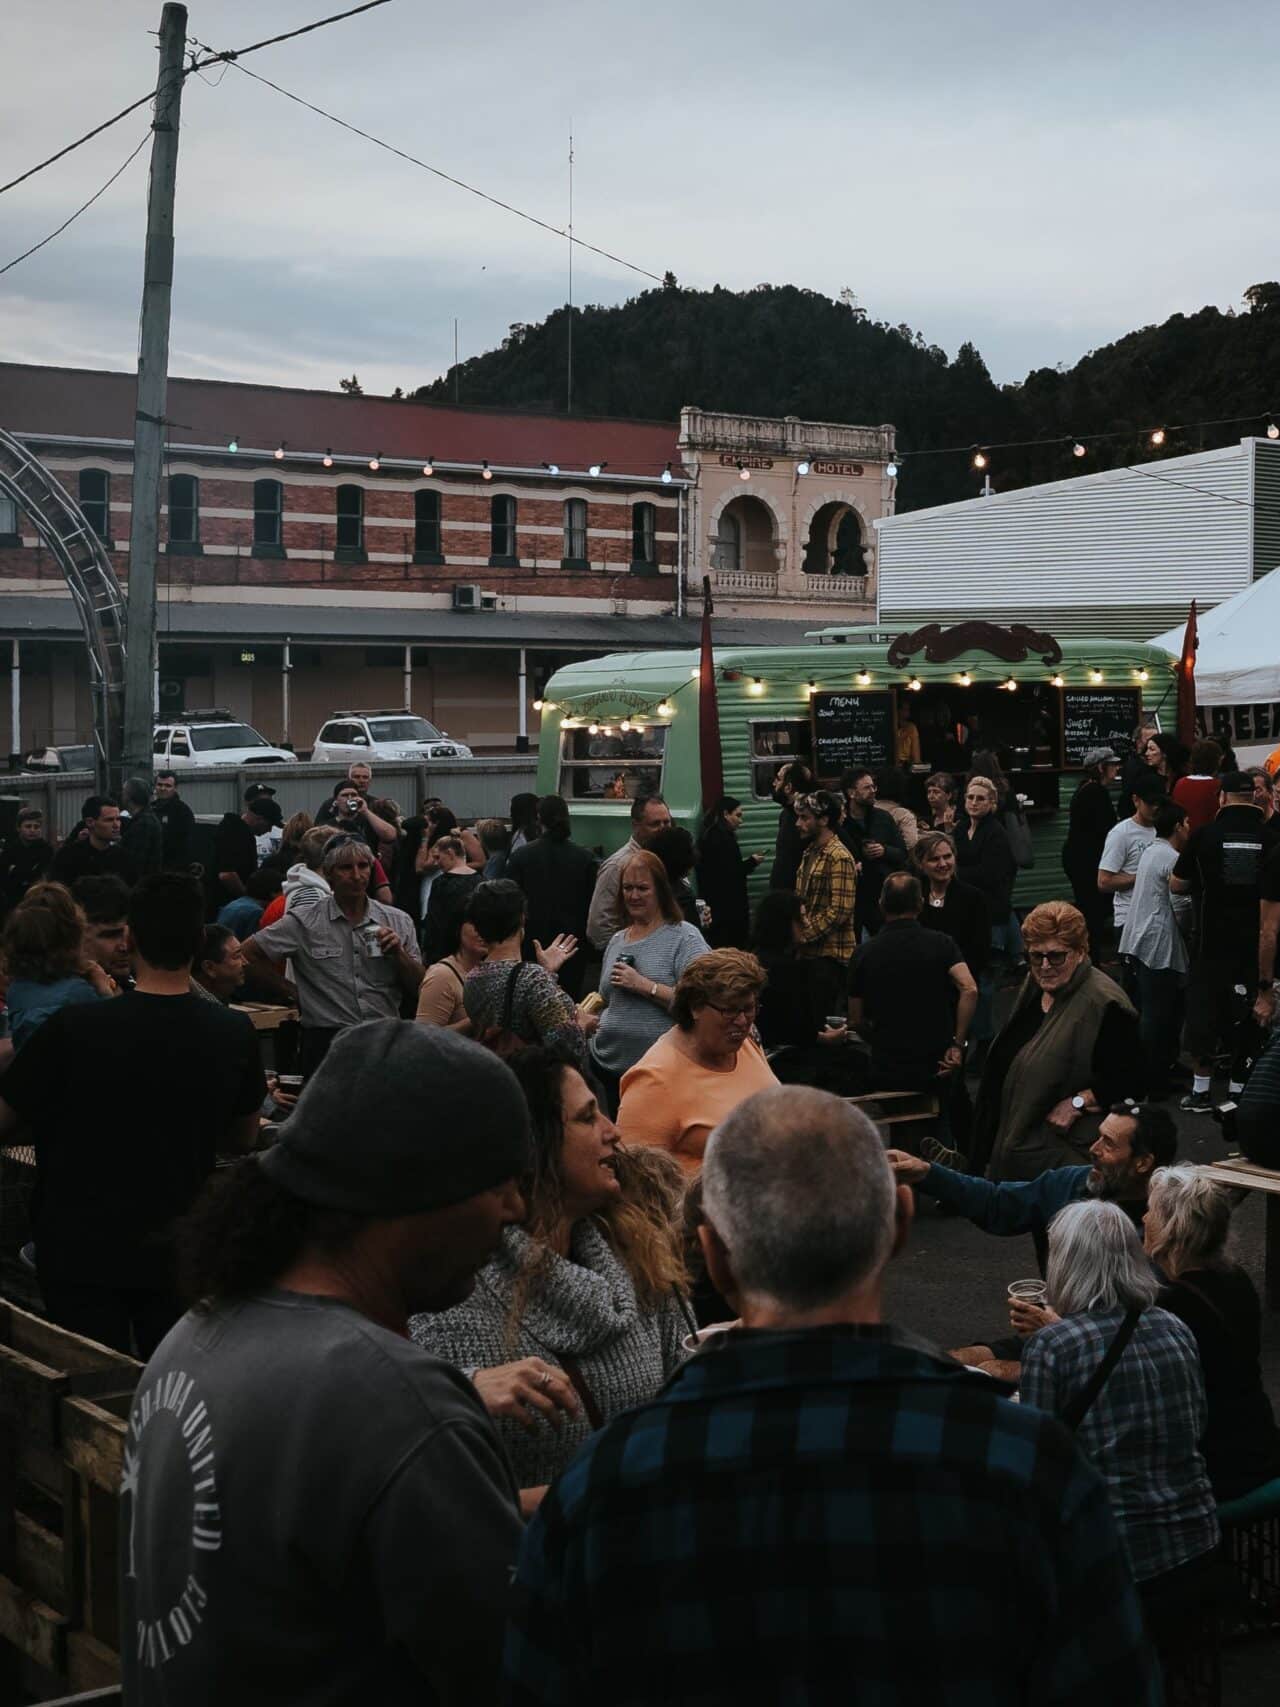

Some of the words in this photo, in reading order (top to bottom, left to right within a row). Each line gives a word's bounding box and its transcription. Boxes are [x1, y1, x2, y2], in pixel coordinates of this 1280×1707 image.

[723, 454, 771, 469] EMPIRE
[818, 463, 860, 475] HOTEL
[829, 697, 860, 707] MENU
[182, 1400, 222, 1551] UNITED
